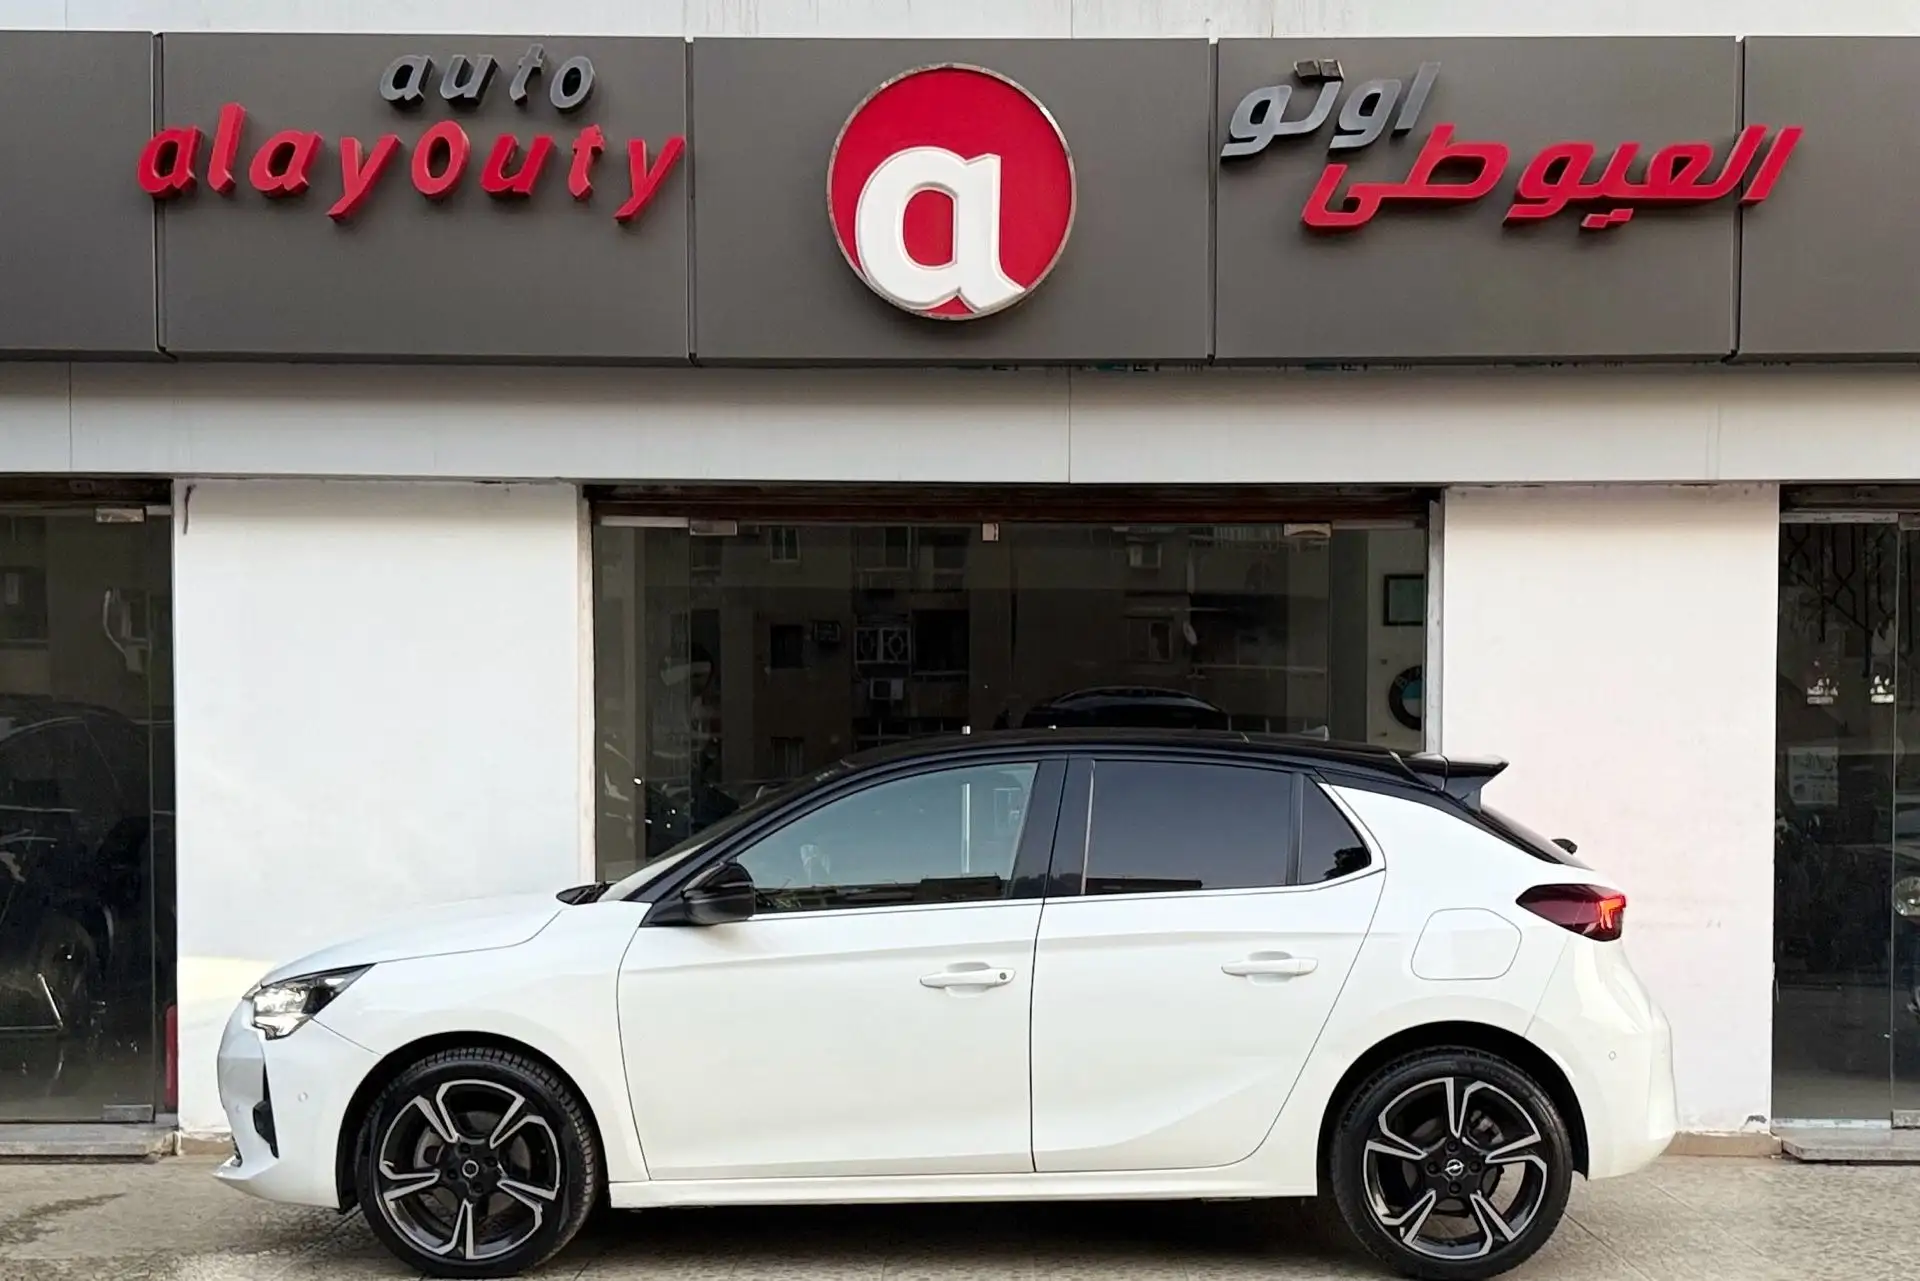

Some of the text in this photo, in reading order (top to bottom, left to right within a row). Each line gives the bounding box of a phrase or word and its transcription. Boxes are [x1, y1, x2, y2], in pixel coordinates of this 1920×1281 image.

[379, 43, 596, 113] auto
[1220, 59, 1441, 160] اوتو
[137, 102, 686, 223] alayouty
[855, 146, 1026, 313] a
